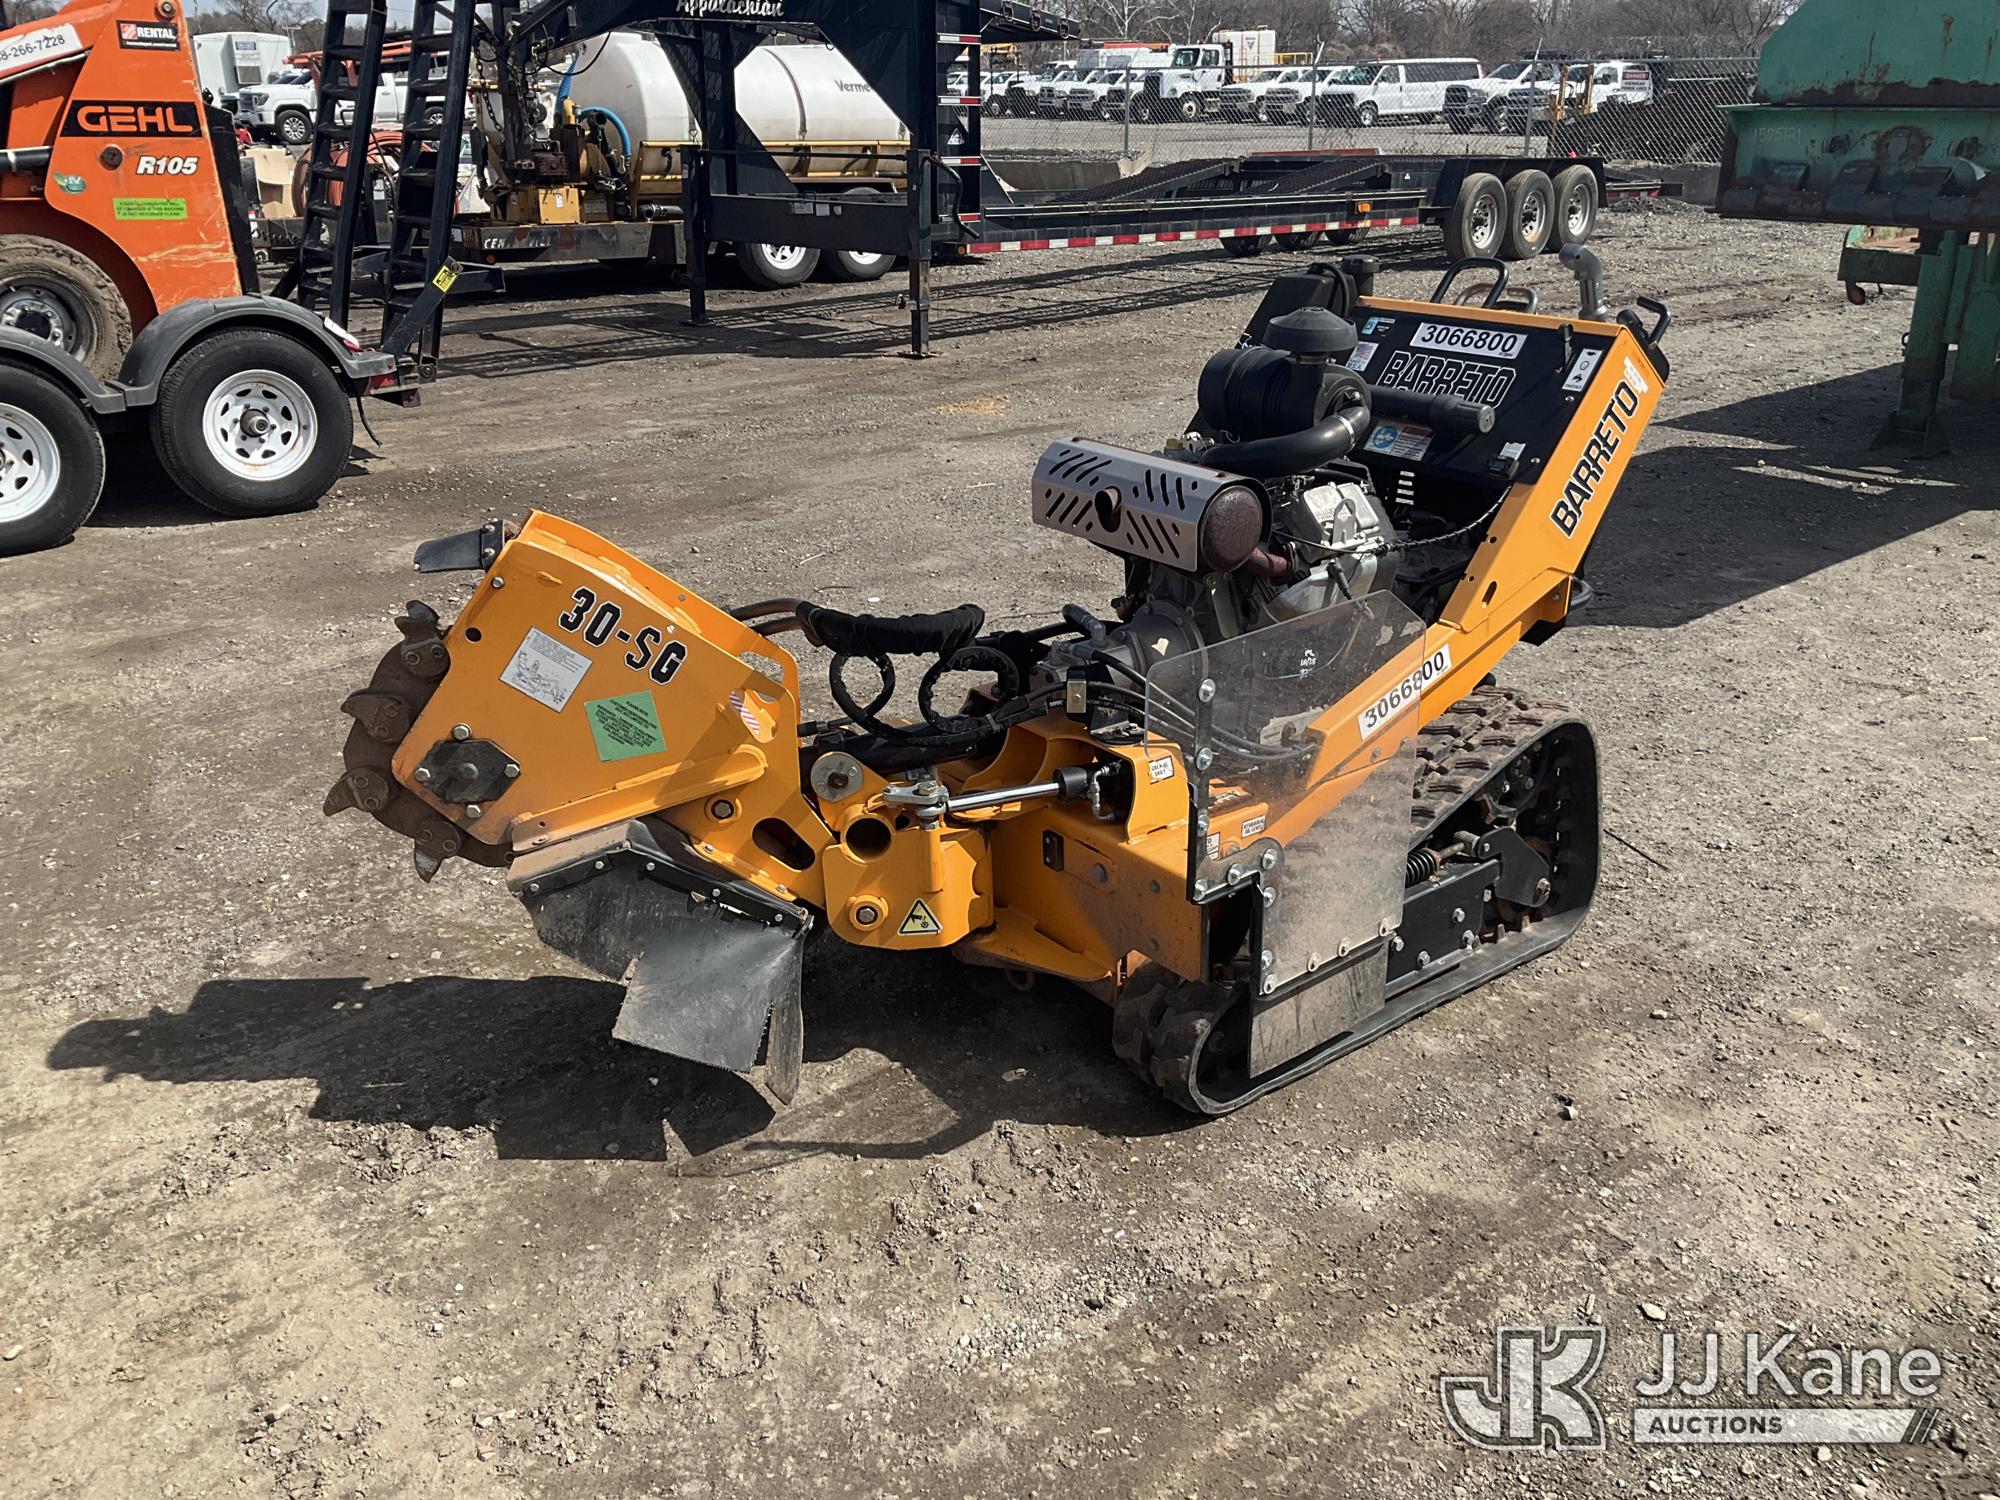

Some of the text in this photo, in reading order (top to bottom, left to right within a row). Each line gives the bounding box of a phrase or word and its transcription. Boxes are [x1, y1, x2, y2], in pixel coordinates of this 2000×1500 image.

[676, 0, 784, 17] Appalachian
[137, 26, 176, 39] RENTAL
[0, 34, 66, 62] 8-266-7228
[834, 79, 871, 92] Verme
[77, 105, 194, 132] GEHL
[136, 156, 199, 175] R105
[1421, 325, 1518, 353] 3066800
[1376, 350, 1516, 410] BARRETO
[1550, 379, 1639, 539] BARRETO
[558, 586, 688, 685] 30-SG
[1365, 651, 1444, 728] 3066800
